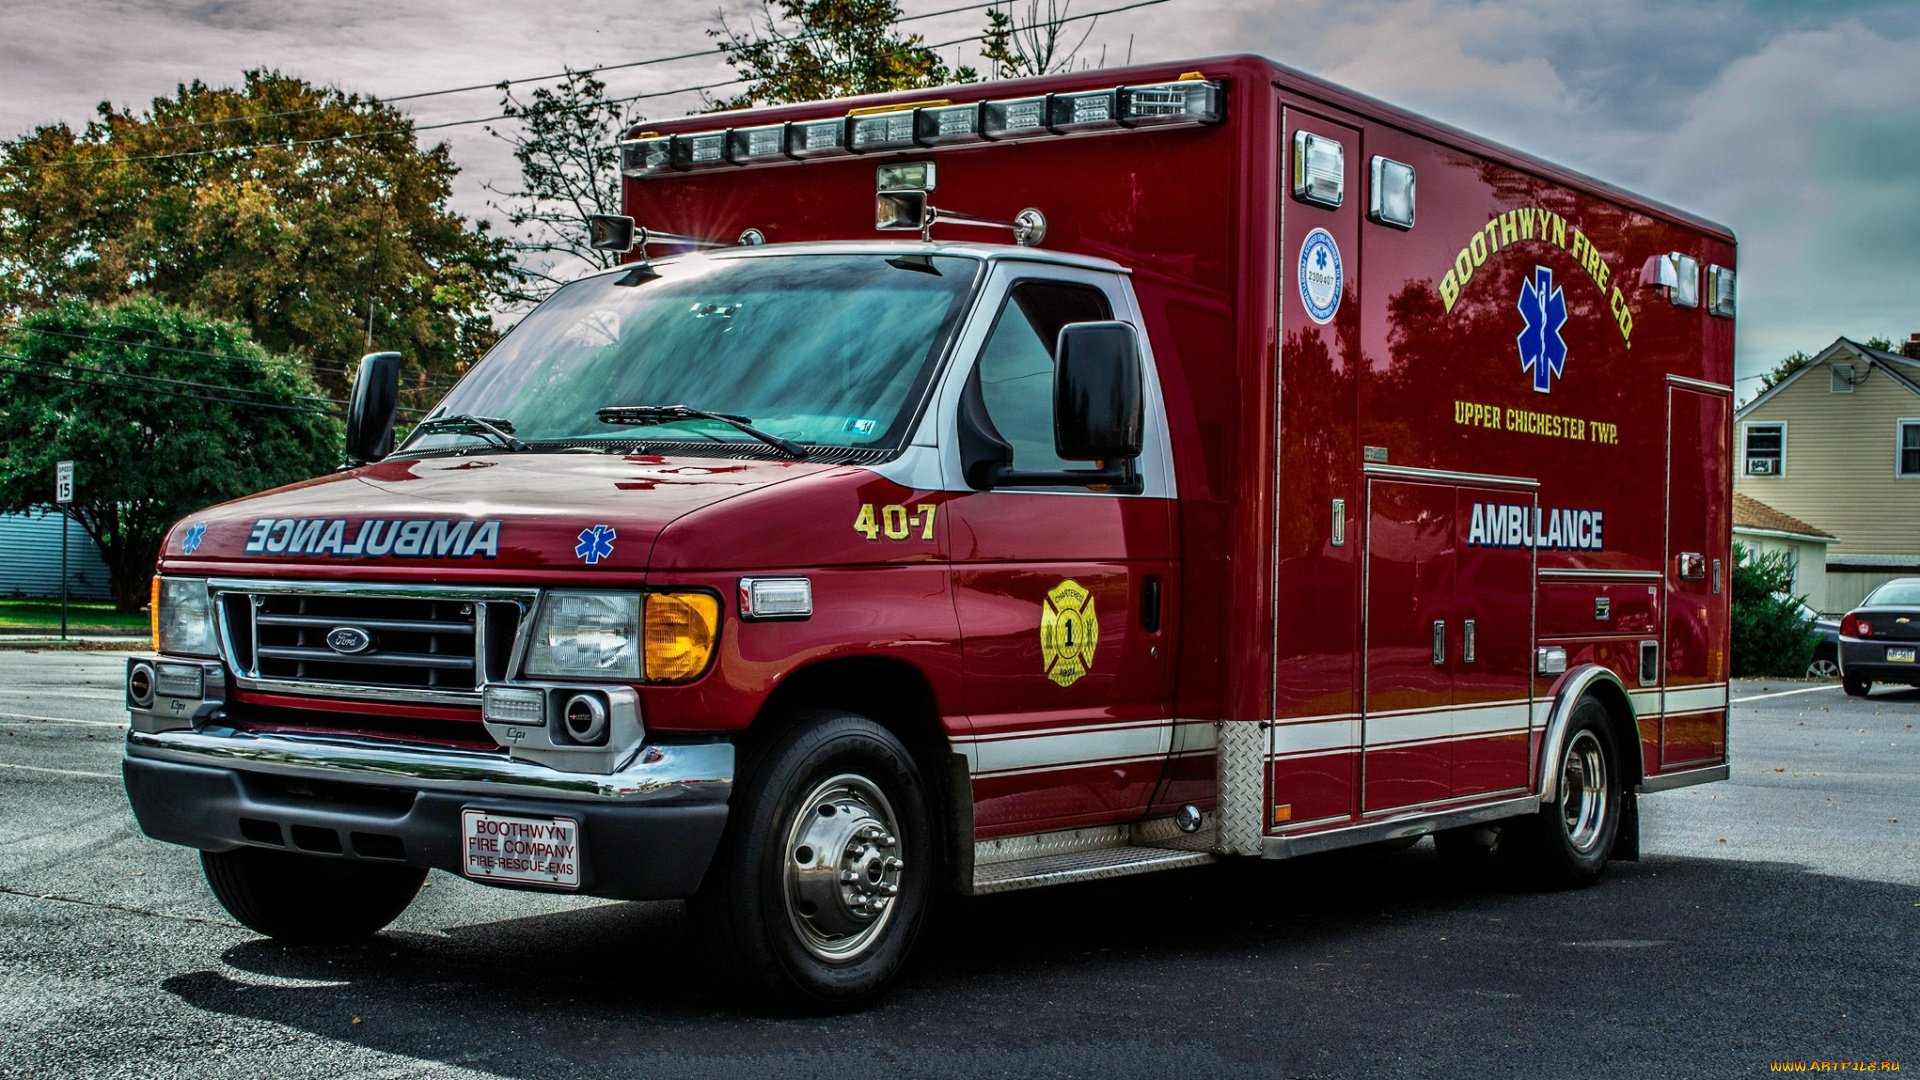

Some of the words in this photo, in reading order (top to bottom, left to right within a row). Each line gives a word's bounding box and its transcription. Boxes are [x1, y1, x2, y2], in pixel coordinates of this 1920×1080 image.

[1308, 270, 1334, 286] 2300407
[1438, 207, 1567, 314] BOOTHWYN
[1572, 227, 1611, 296] FIRE
[1610, 287, 1633, 351] CO.
[1454, 400, 1501, 430] UPPER
[1505, 408, 1586, 441] CHICHESTER
[1589, 420, 1619, 445] TWP.
[58, 465, 72, 473] SPEED
[59, 482, 70, 498] 15
[853, 503, 937, 541] 40-7
[1468, 502, 1604, 550] AMBULANCE
[1055, 589, 1084, 604] CHARTERED
[1064, 618, 1074, 647] 1
[476, 819, 567, 842] BOOTHWYN
[468, 836, 499, 853] FIRE
[503, 839, 575, 860] COMPANY
[469, 854, 575, 876] FIRE-RESCUE-EMS
